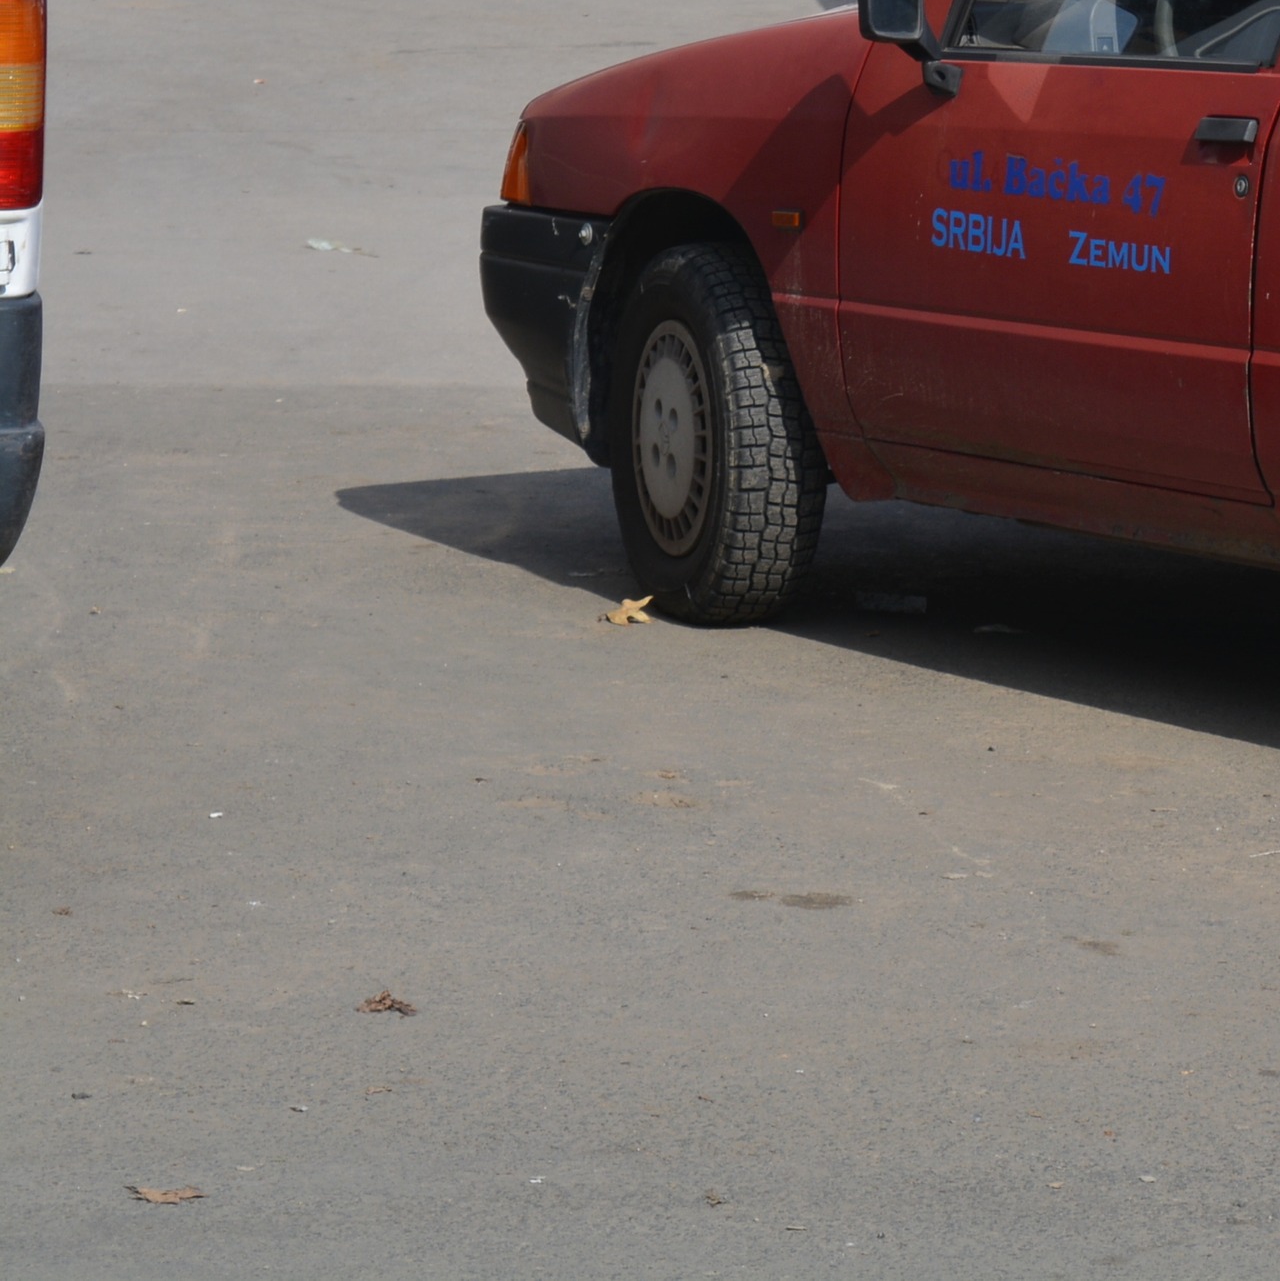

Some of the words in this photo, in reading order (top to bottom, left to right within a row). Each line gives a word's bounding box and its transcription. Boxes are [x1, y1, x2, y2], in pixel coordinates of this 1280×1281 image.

[948, 150, 991, 192] ul.
[1003, 152, 1110, 205] Bačka
[1122, 172, 1166, 217] 47
[930, 207, 1026, 260] SRBIJA
[1068, 230, 1172, 274] ZEMUN
